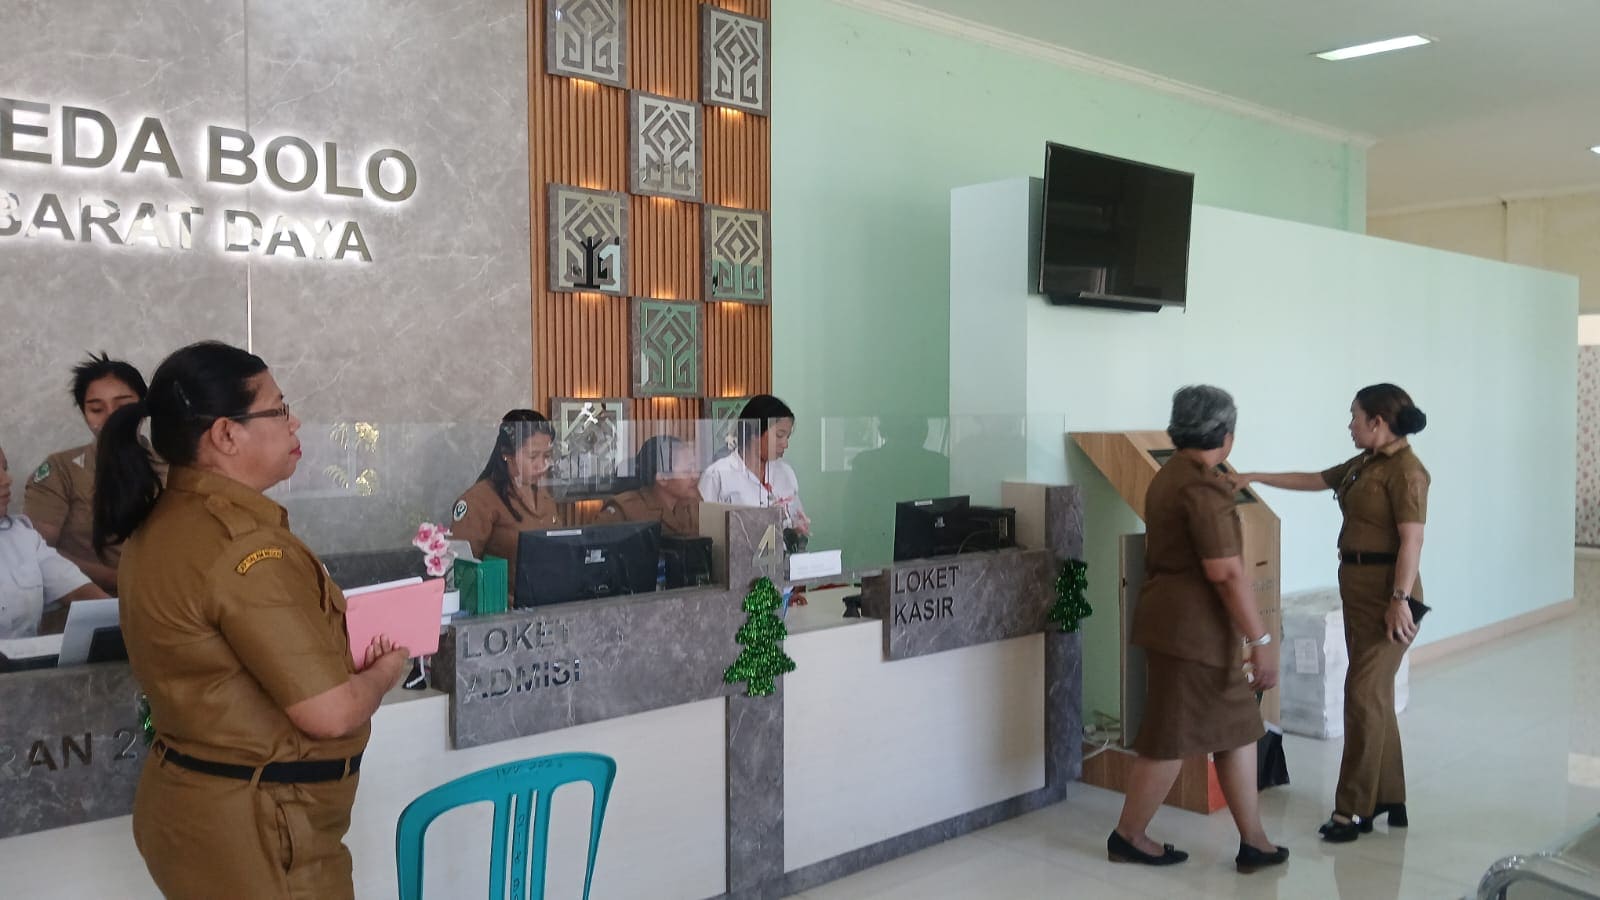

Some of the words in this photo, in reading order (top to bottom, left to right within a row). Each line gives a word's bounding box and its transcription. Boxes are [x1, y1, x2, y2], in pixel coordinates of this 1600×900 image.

[206, 125, 418, 203] BOLO
[224, 208, 373, 262] DAYA
[752, 523, 781, 577] 4
[894, 564, 960, 595] LOKET
[894, 597, 955, 627] KASIR
[462, 617, 577, 660] LOKET
[462, 659, 582, 705] ADMISI
[113, 728, 139, 761] 2
